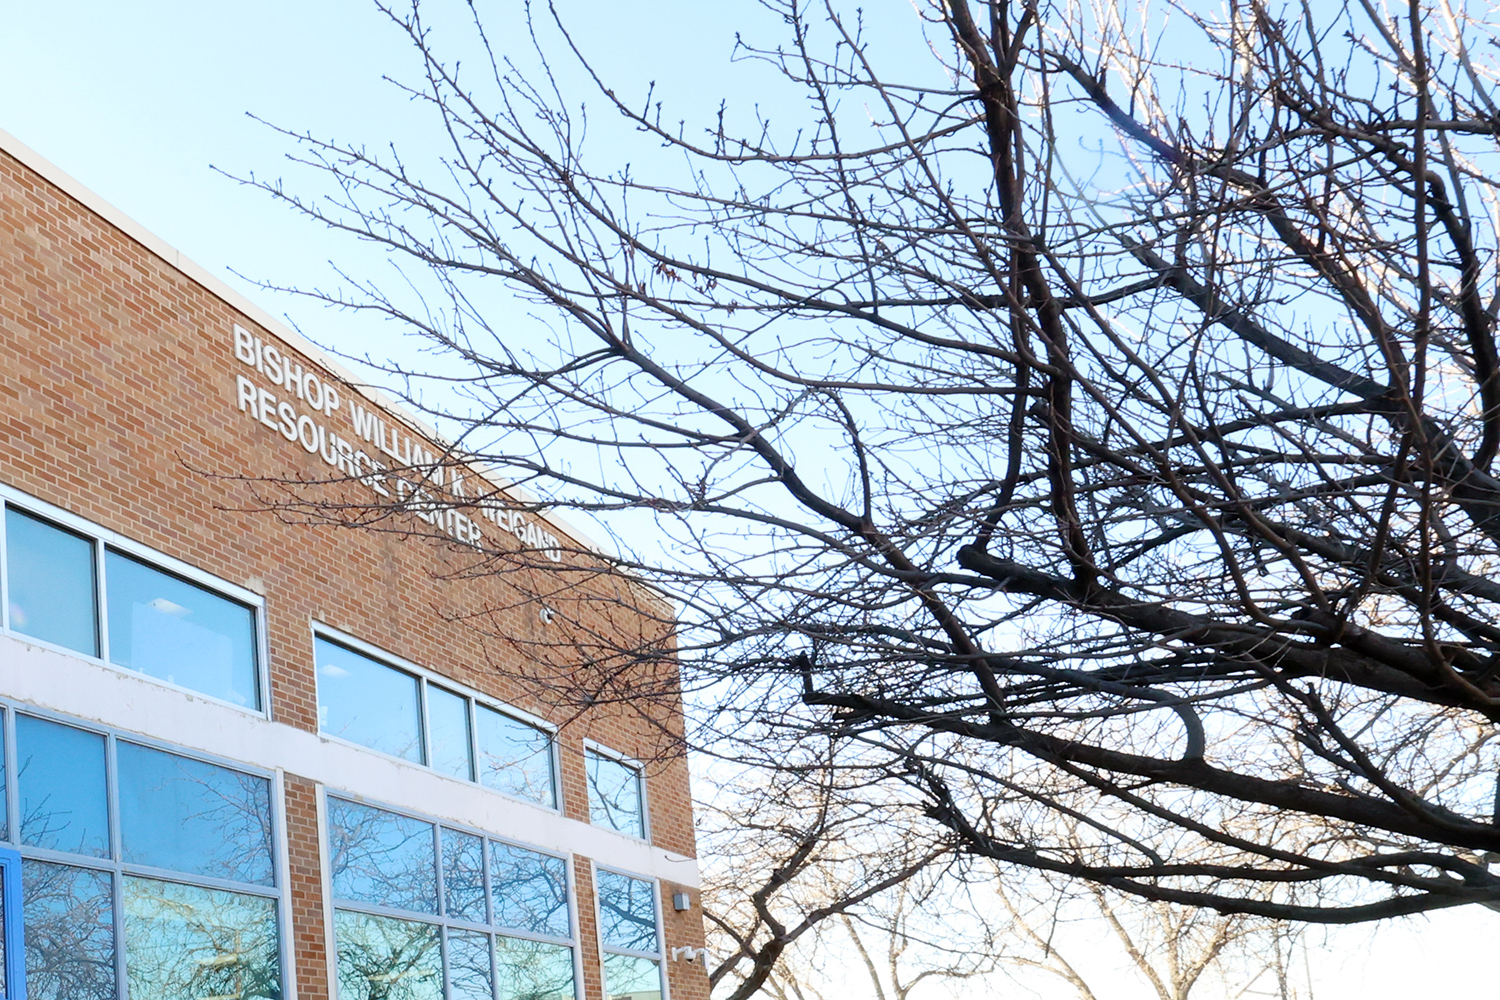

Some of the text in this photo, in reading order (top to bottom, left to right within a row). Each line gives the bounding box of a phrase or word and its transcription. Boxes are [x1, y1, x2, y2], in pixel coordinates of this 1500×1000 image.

[233, 323, 340, 418] BISHOP
[350, 399, 445, 487] WILLIAM
[476, 486, 562, 563] WEIGAND
[236, 374, 483, 553] RESOURCE CENTER
